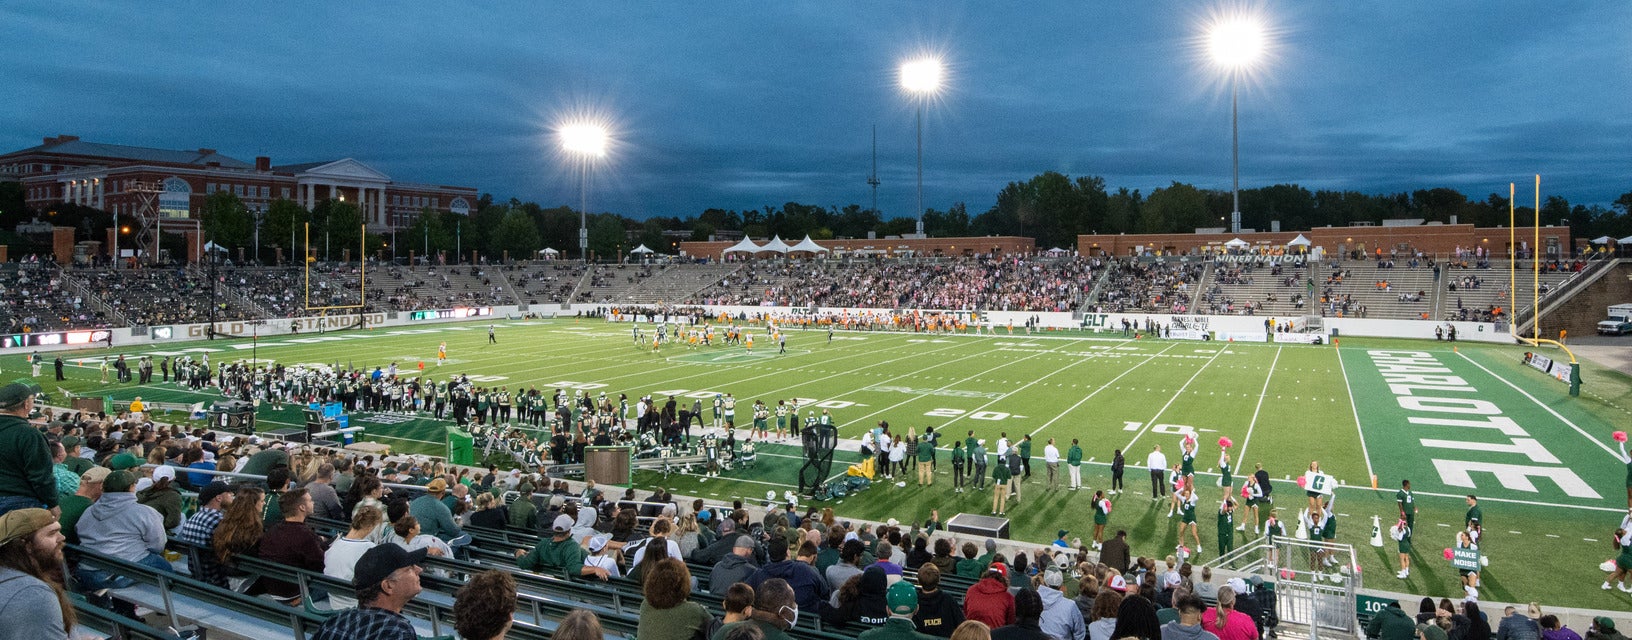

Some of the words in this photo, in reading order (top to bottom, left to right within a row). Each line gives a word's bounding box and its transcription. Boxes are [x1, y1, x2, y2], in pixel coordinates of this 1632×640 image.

[1254, 255, 1304, 263] NATION
[1084, 314, 1108, 326] CLT
[923, 408, 1010, 420] 20
[1123, 421, 1195, 434] 10
[1367, 350, 1604, 499] CHARLOTTE
[1454, 550, 1476, 559] MAKE
[1453, 559, 1477, 568] NOISE
